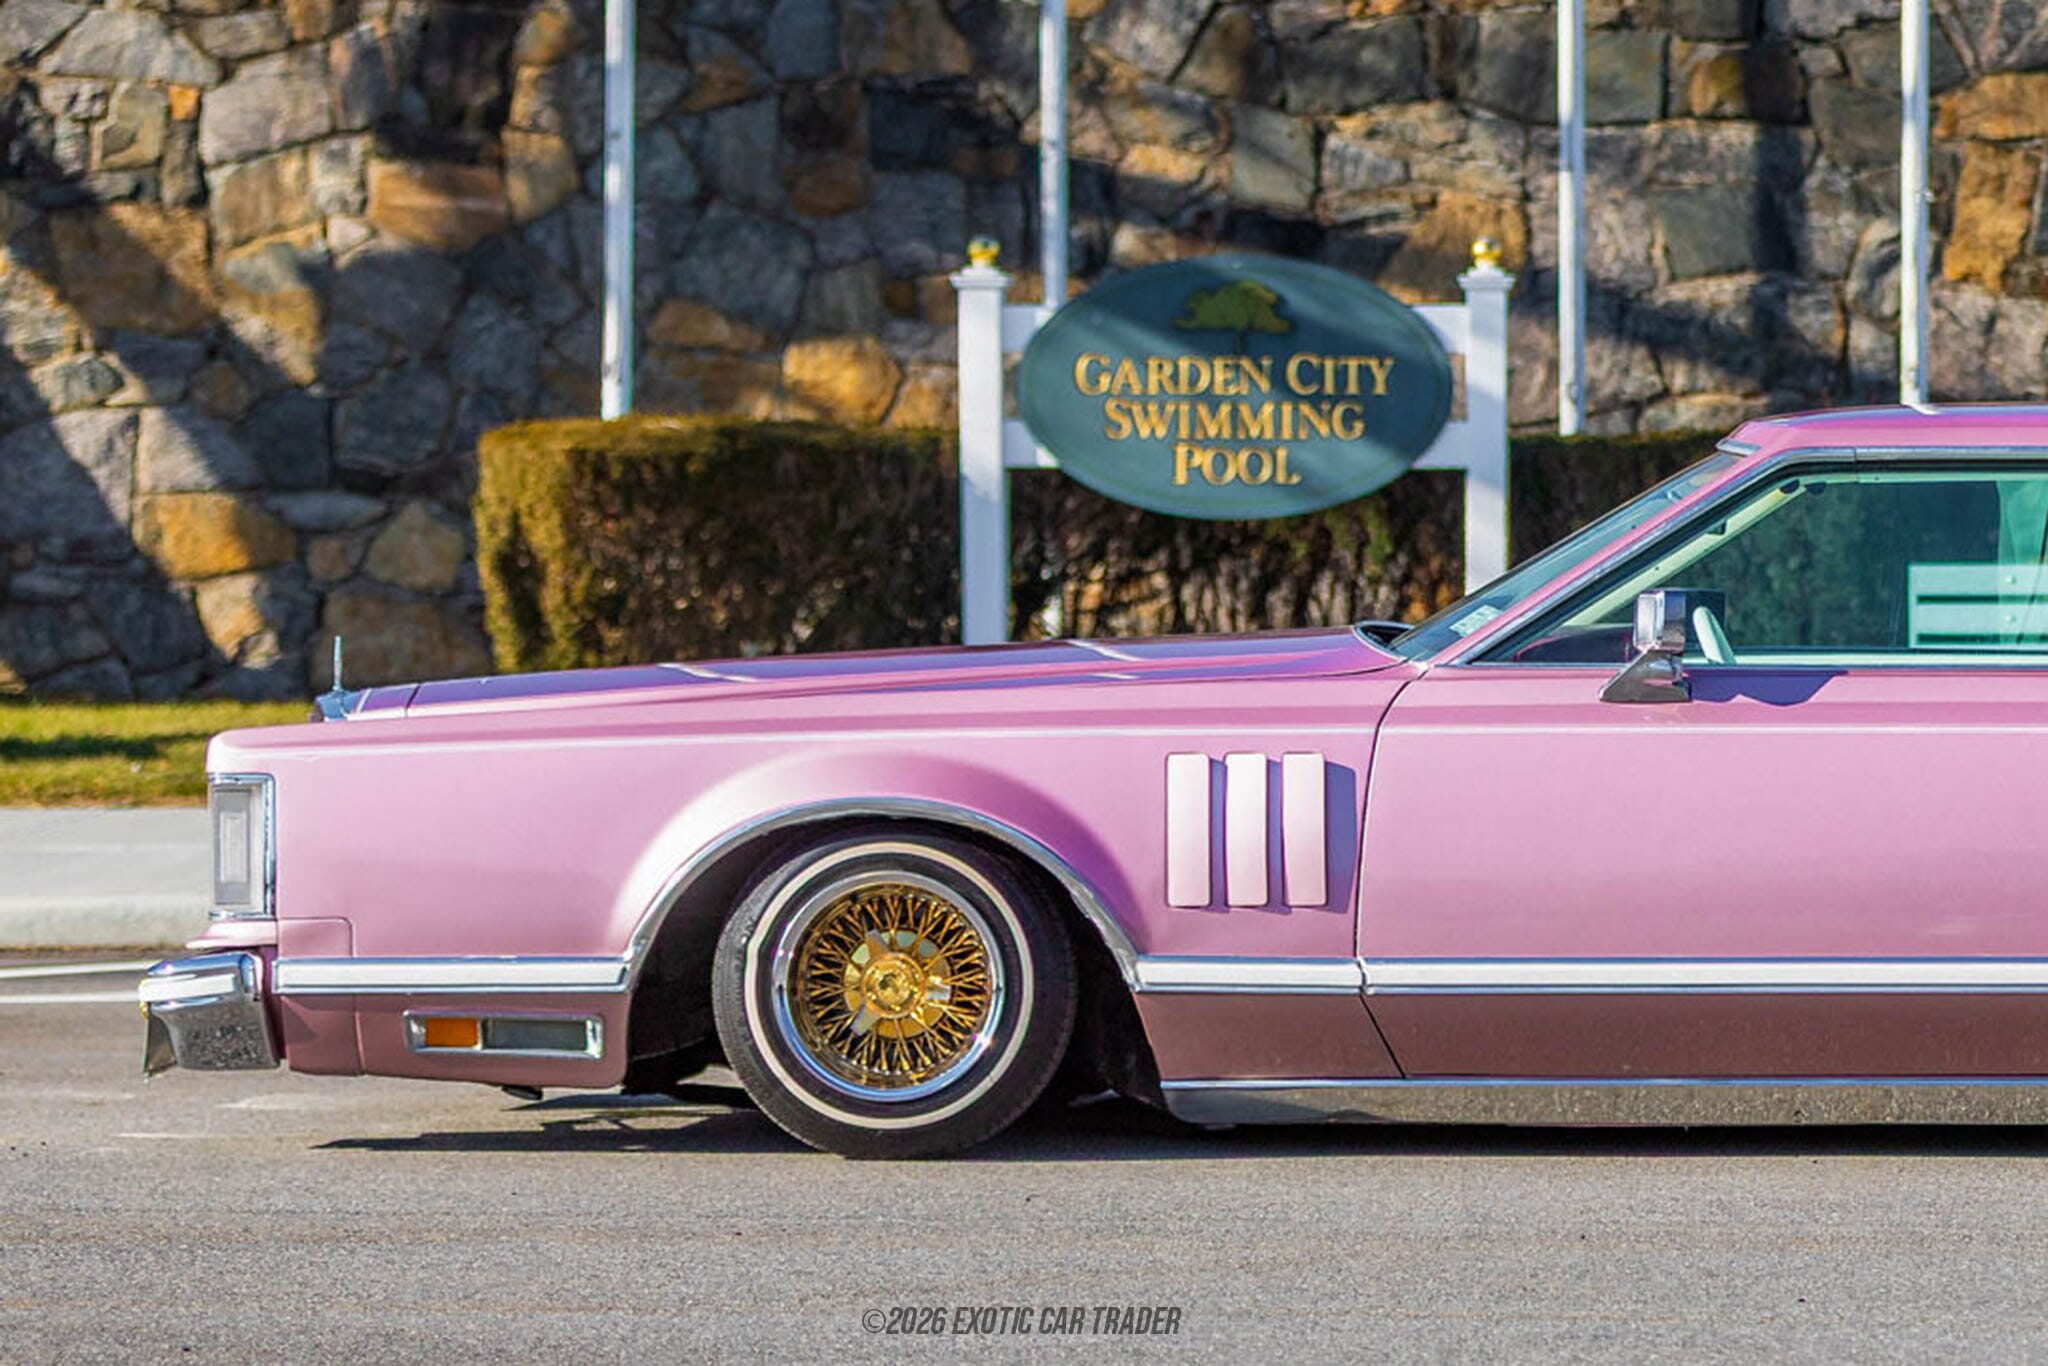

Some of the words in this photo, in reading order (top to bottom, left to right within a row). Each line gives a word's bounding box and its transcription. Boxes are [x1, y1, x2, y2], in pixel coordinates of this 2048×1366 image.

[1074, 353, 1272, 396] GARDEN
[1285, 353, 1396, 396] CITY
[1103, 398, 1365, 441] SWIMMING
[1172, 442, 1302, 486] POOL
